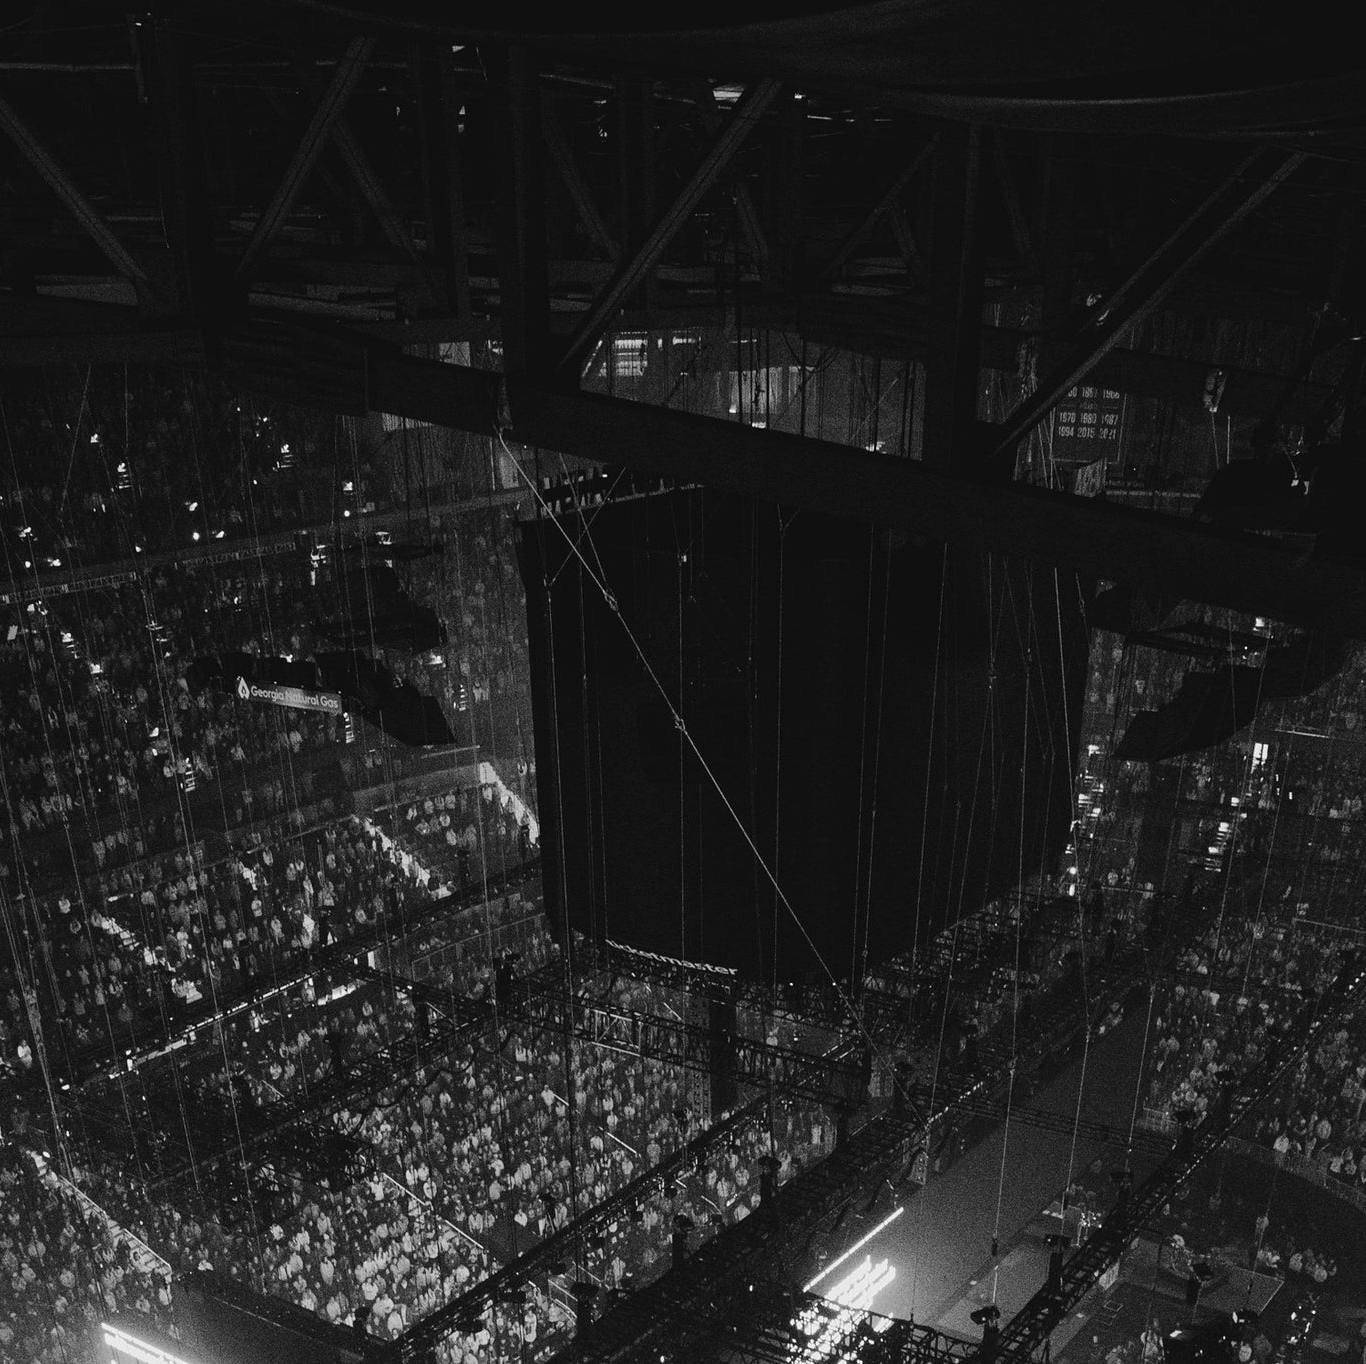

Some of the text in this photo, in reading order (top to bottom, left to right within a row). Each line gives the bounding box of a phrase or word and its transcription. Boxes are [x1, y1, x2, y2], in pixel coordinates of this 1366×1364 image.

[250, 685, 339, 709] Georgia Natural Gas
[604, 938, 739, 976] ticketmaster
